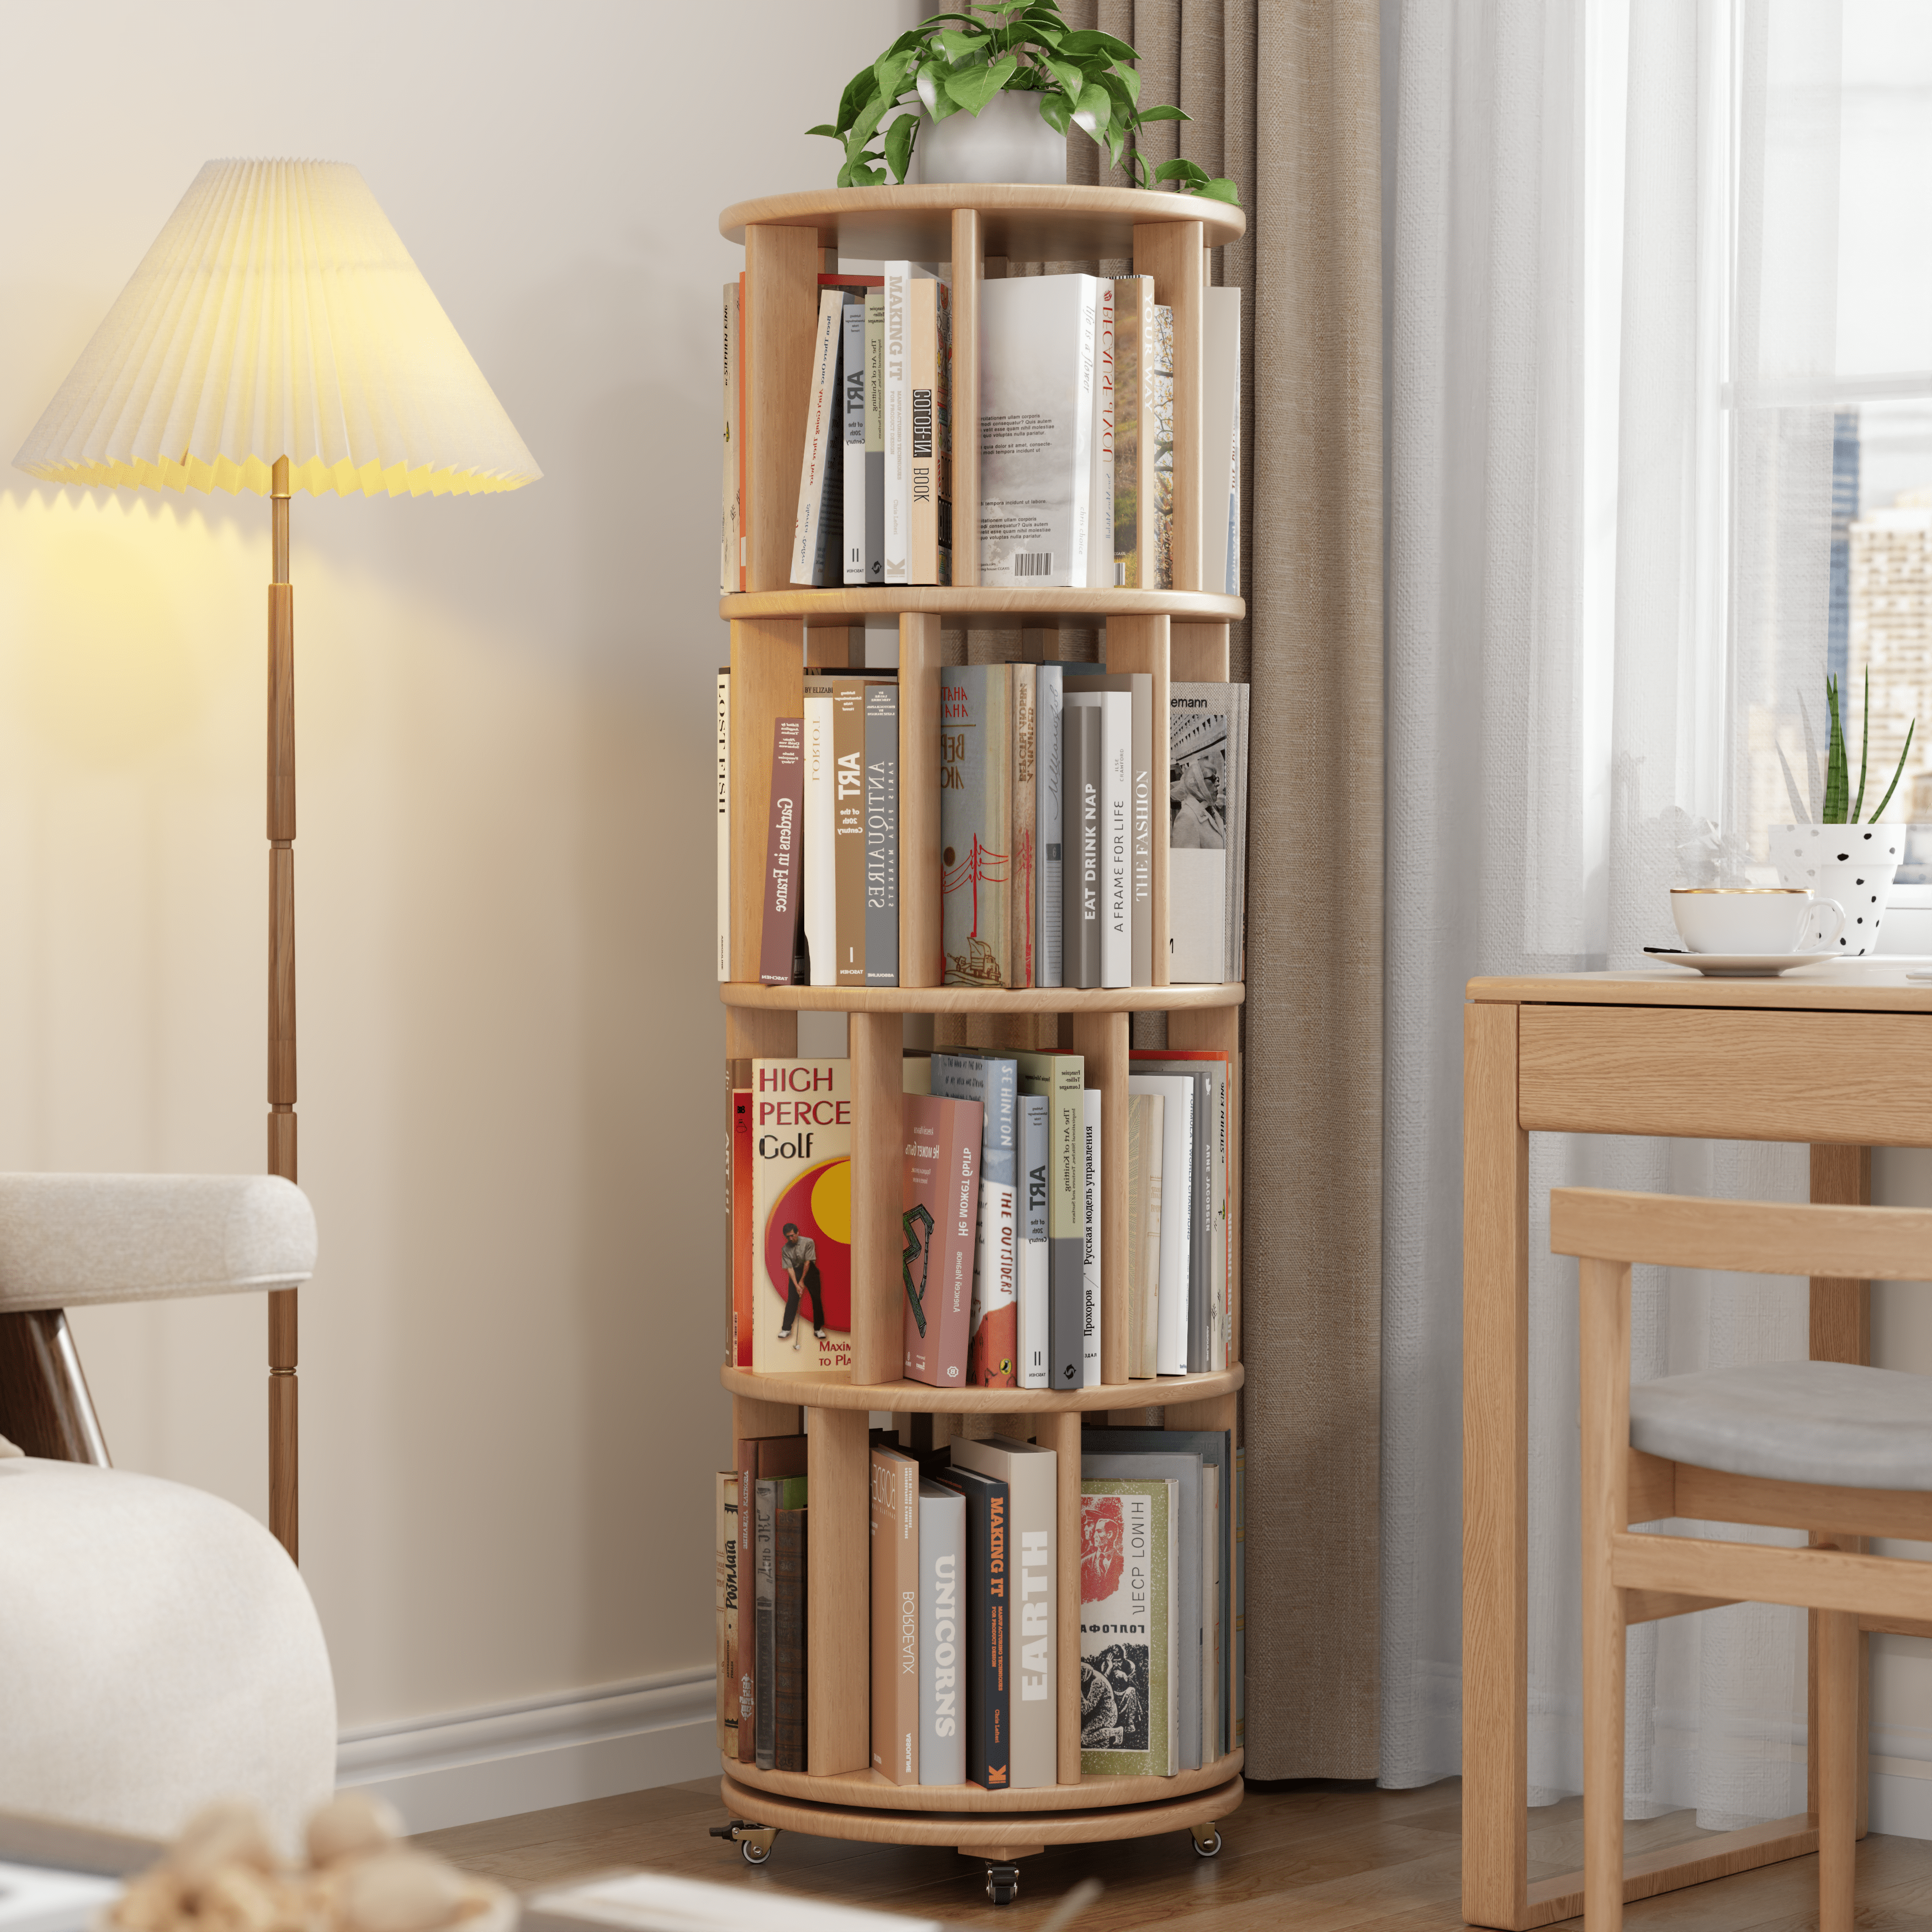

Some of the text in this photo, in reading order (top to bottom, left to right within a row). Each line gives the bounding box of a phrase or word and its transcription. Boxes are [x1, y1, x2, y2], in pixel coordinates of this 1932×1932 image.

[889, 275, 903, 381] MAKING IT
[1082, 305, 1095, 394] life is flower
[1144, 292, 1153, 413] YOUR WAY
[1171, 698, 1207, 708] emann
[1085, 783, 1096, 920] EAT DRINK NAP
[1114, 801, 1123, 932] A FRAME FOR LIFE
[1136, 769, 1148, 902] THE FASHION
[760, 1068, 832, 1092] HIGH
[760, 1101, 851, 1126] PERCE
[1000, 1088, 1013, 1147] HINTON
[759, 1133, 814, 1159] Golf
[1086, 1126, 1095, 1187] управления
[1001, 1192, 1013, 1294] THE OUTSIDERS
[1084, 1226, 1095, 1265] Русская
[1084, 1289, 1095, 1336] Прохоров
[725, 1540, 738, 1610] Розплата
[991, 1496, 1004, 1597] MAKING IT
[935, 1554, 956, 1738] UNICORNS
[1022, 1531, 1047, 1701] EARTH
